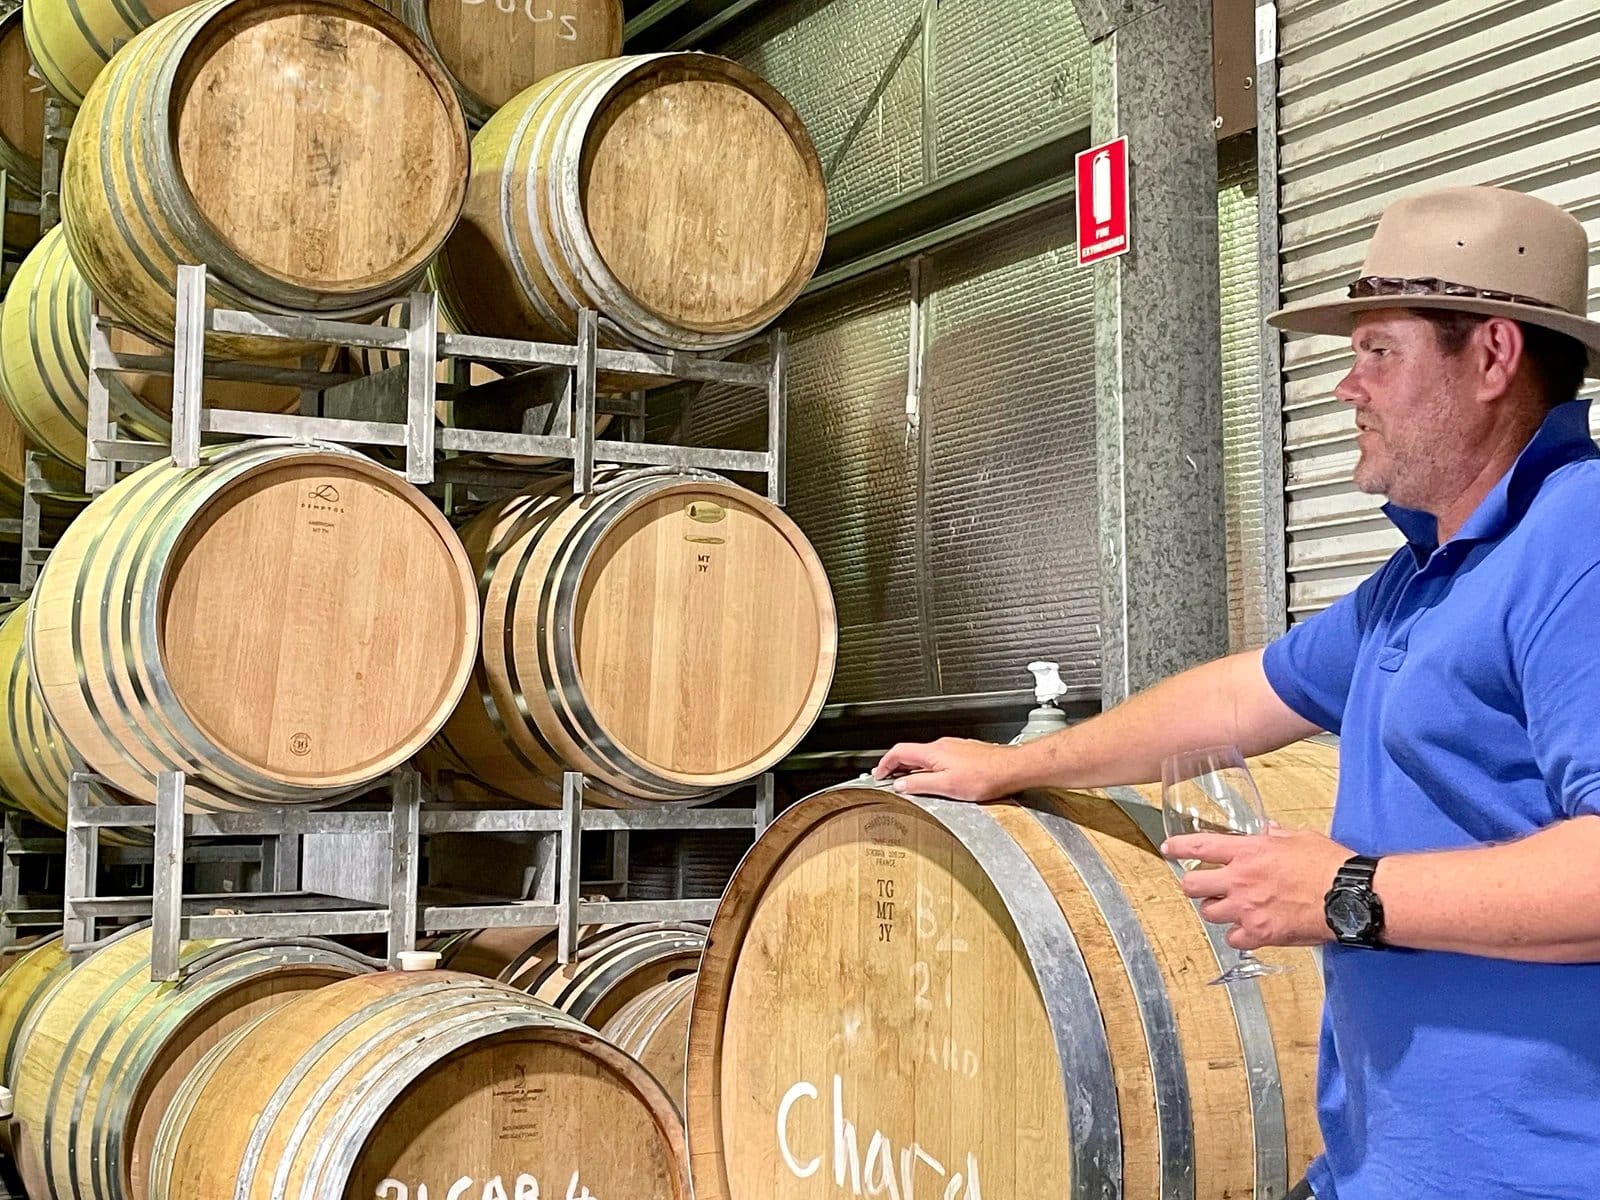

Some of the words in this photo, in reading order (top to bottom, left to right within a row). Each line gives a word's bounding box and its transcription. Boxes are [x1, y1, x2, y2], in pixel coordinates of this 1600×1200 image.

[1095, 226, 1110, 240] FIRE
[697, 554, 710, 563] MT
[876, 879, 895, 898] TG
[876, 900, 896, 920] MT
